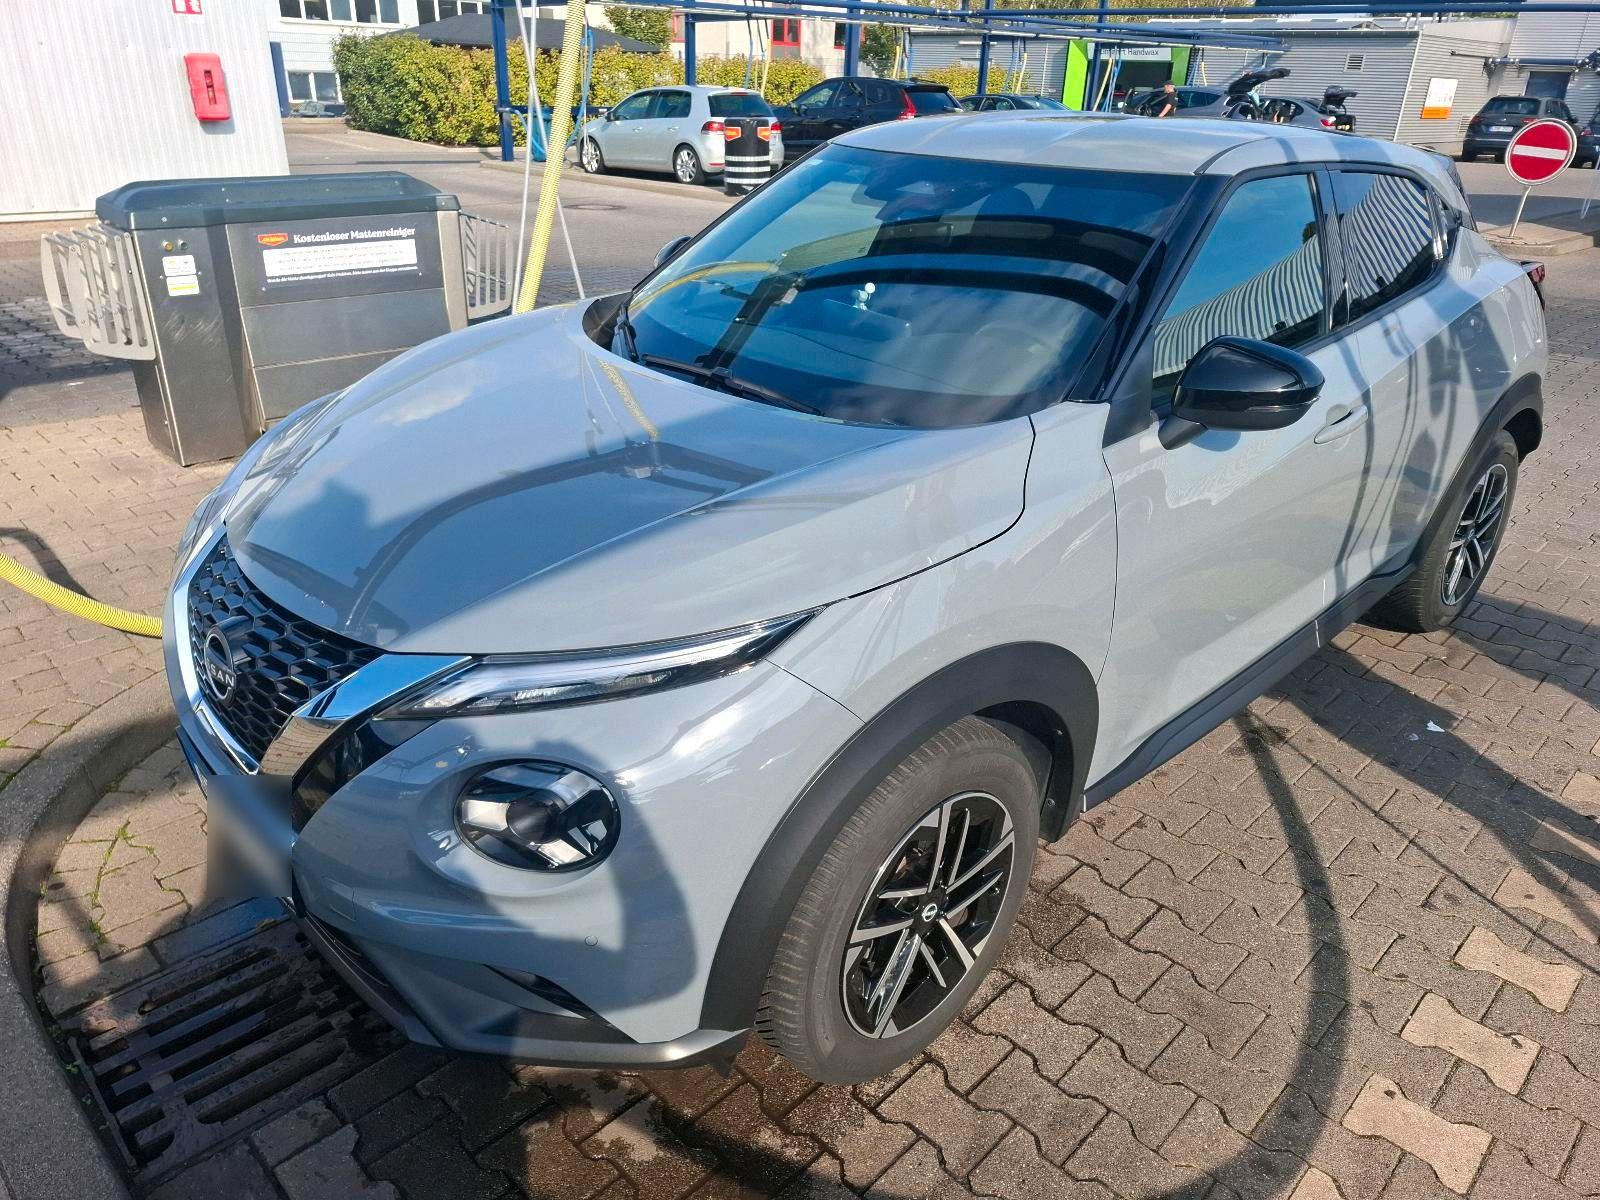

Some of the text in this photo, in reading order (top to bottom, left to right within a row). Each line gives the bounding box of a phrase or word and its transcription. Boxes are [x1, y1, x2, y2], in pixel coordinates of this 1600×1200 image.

[1128, 47, 1159, 56] Handwax
[293, 231, 349, 244] Kostenloser
[350, 226, 416, 240] Mattenreiniger
